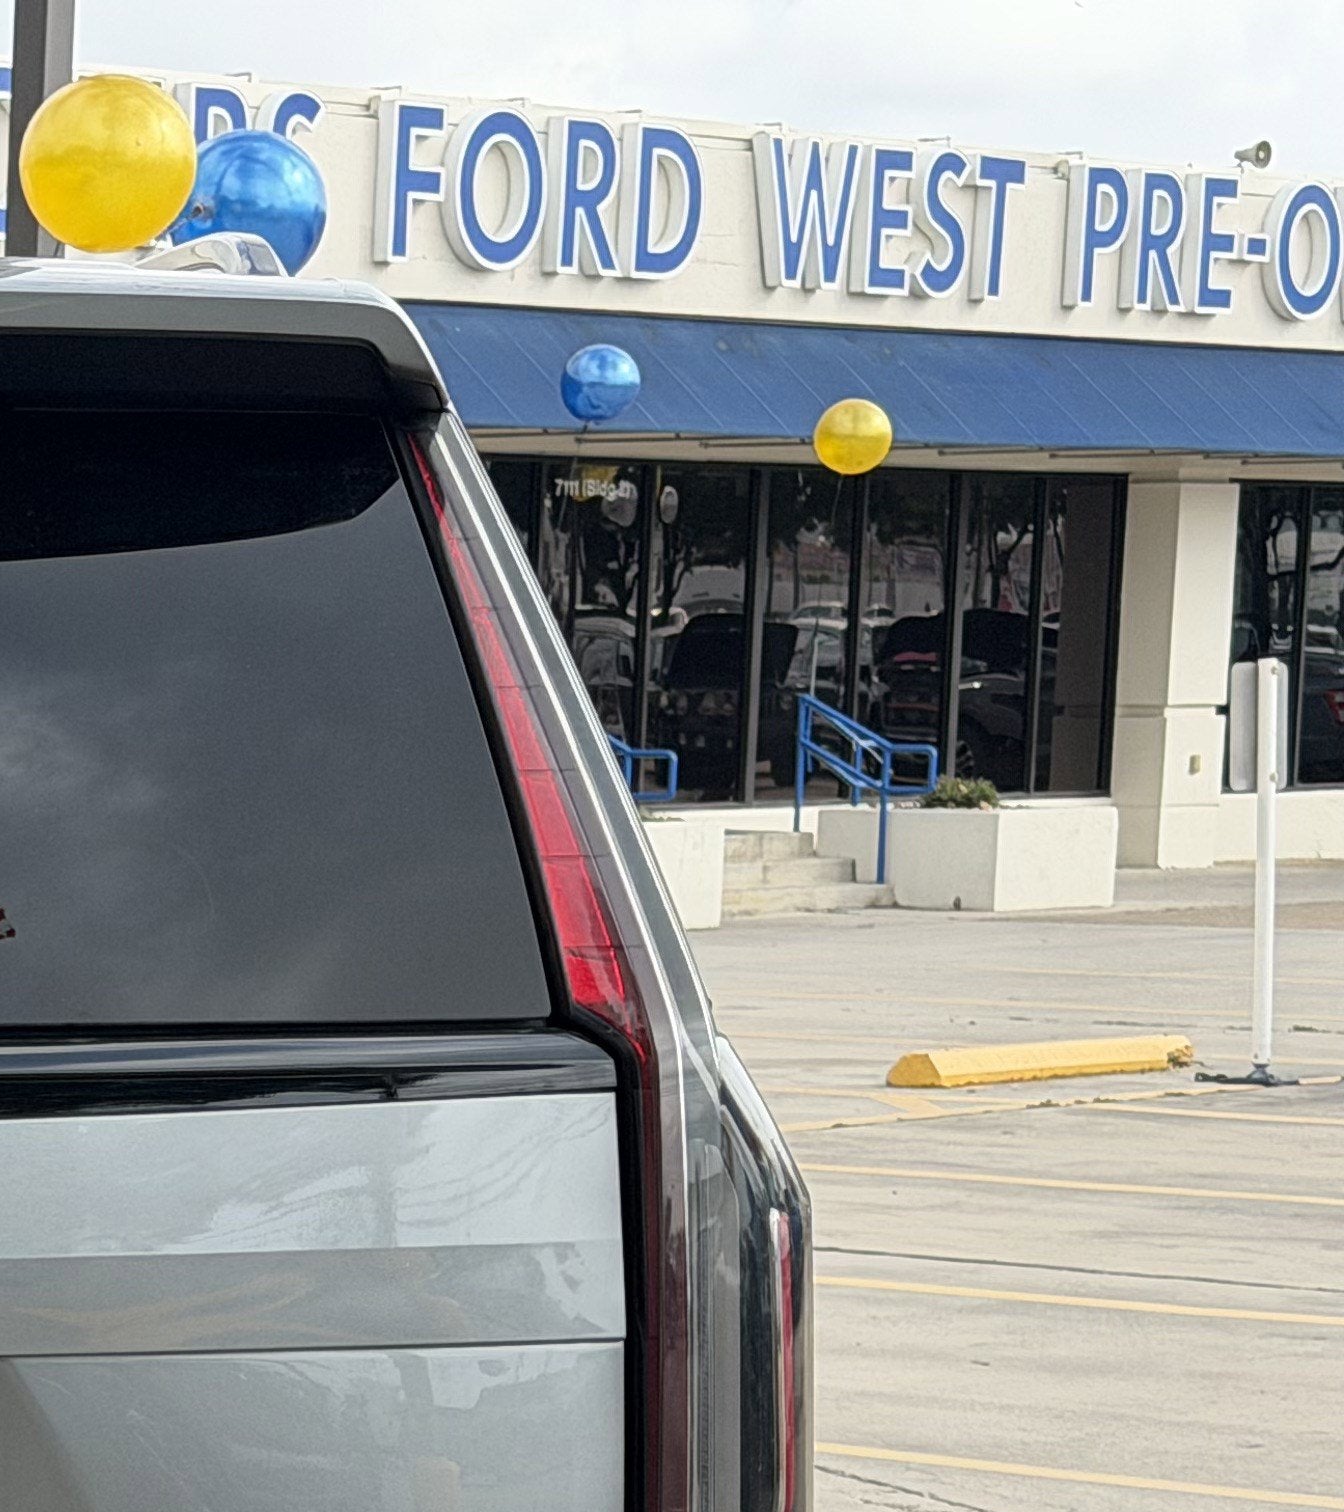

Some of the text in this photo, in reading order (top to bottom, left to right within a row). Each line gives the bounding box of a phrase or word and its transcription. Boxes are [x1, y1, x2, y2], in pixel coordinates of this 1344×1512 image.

[374, 98, 704, 281] FORD
[753, 130, 1026, 302] WEST
[1063, 163, 1343, 322] PRE-O
[554, 478, 579, 497] 7111
